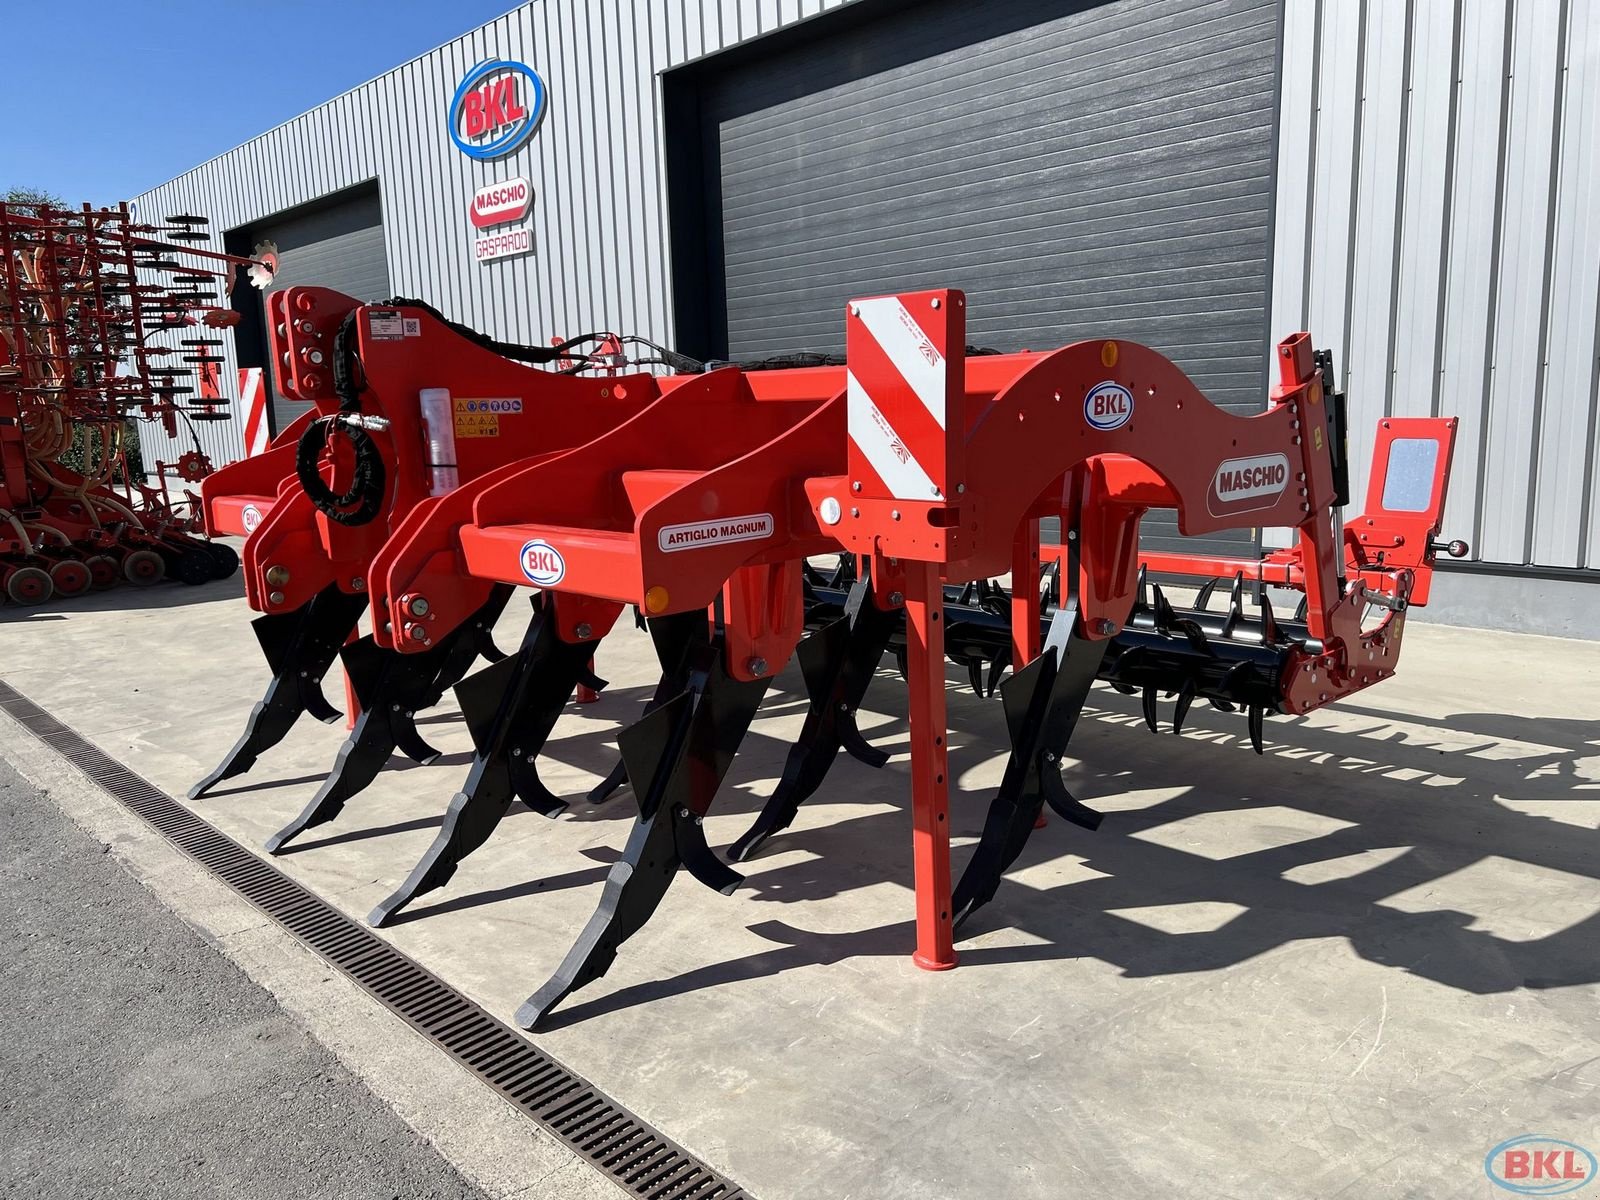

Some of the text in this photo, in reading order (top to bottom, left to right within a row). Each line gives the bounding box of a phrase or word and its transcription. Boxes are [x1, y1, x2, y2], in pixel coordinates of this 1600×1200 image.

[464, 75, 525, 138] BKL
[476, 184, 526, 210] MASCHIO
[476, 231, 529, 259] GASPARDO
[1094, 393, 1127, 416] BKL
[1219, 463, 1285, 493] MASCHIO
[668, 521, 766, 545] ARTIGLIO MAGNUM
[528, 551, 559, 572] BKL
